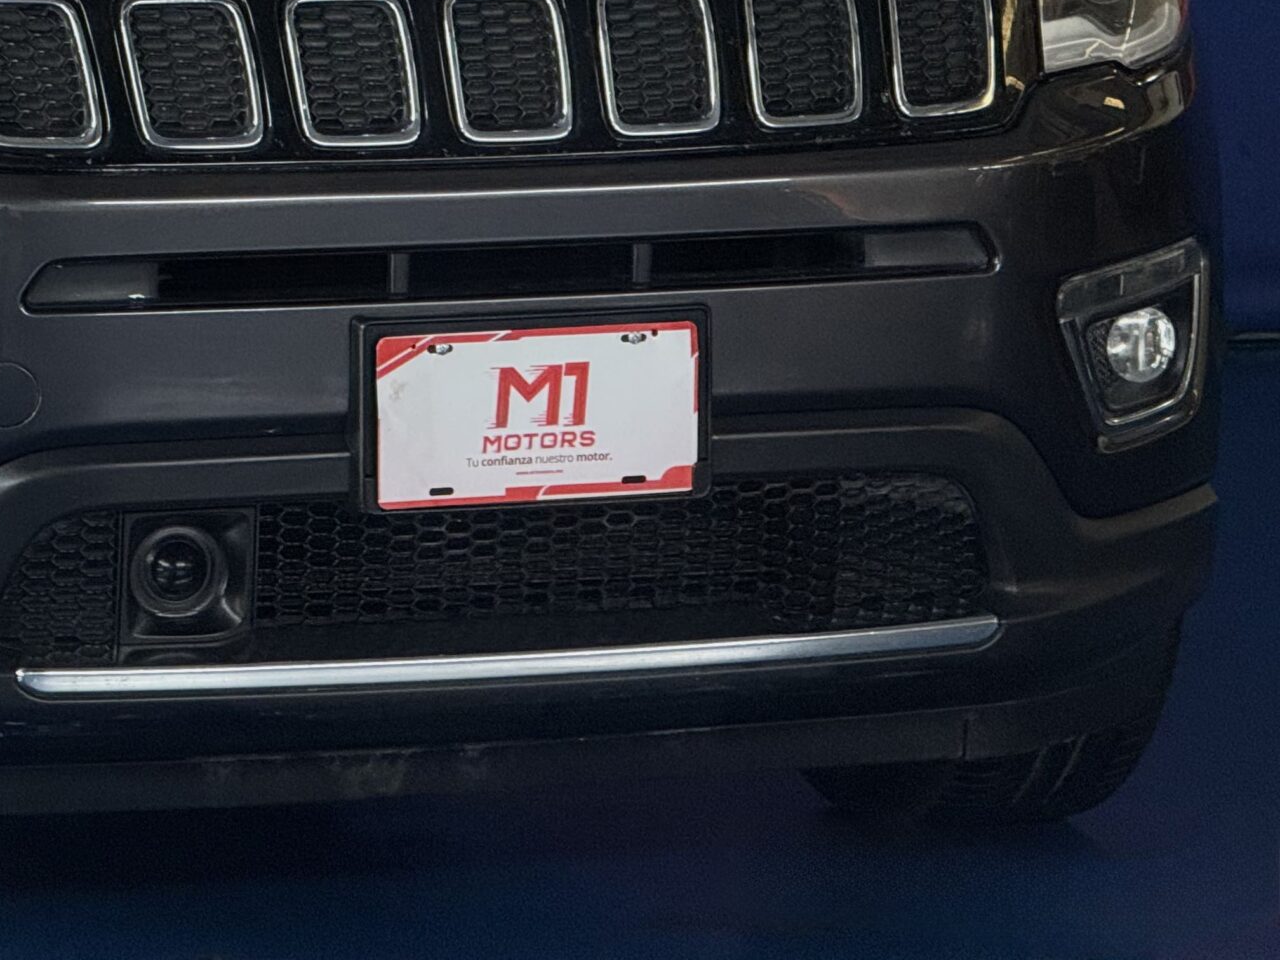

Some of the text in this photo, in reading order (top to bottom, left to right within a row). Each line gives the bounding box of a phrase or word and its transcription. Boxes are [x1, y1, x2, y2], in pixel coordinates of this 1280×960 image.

[484, 361, 590, 429] M1
[482, 431, 596, 454] MOTORS
[466, 451, 613, 468] Tu confianza nuestro motor.
